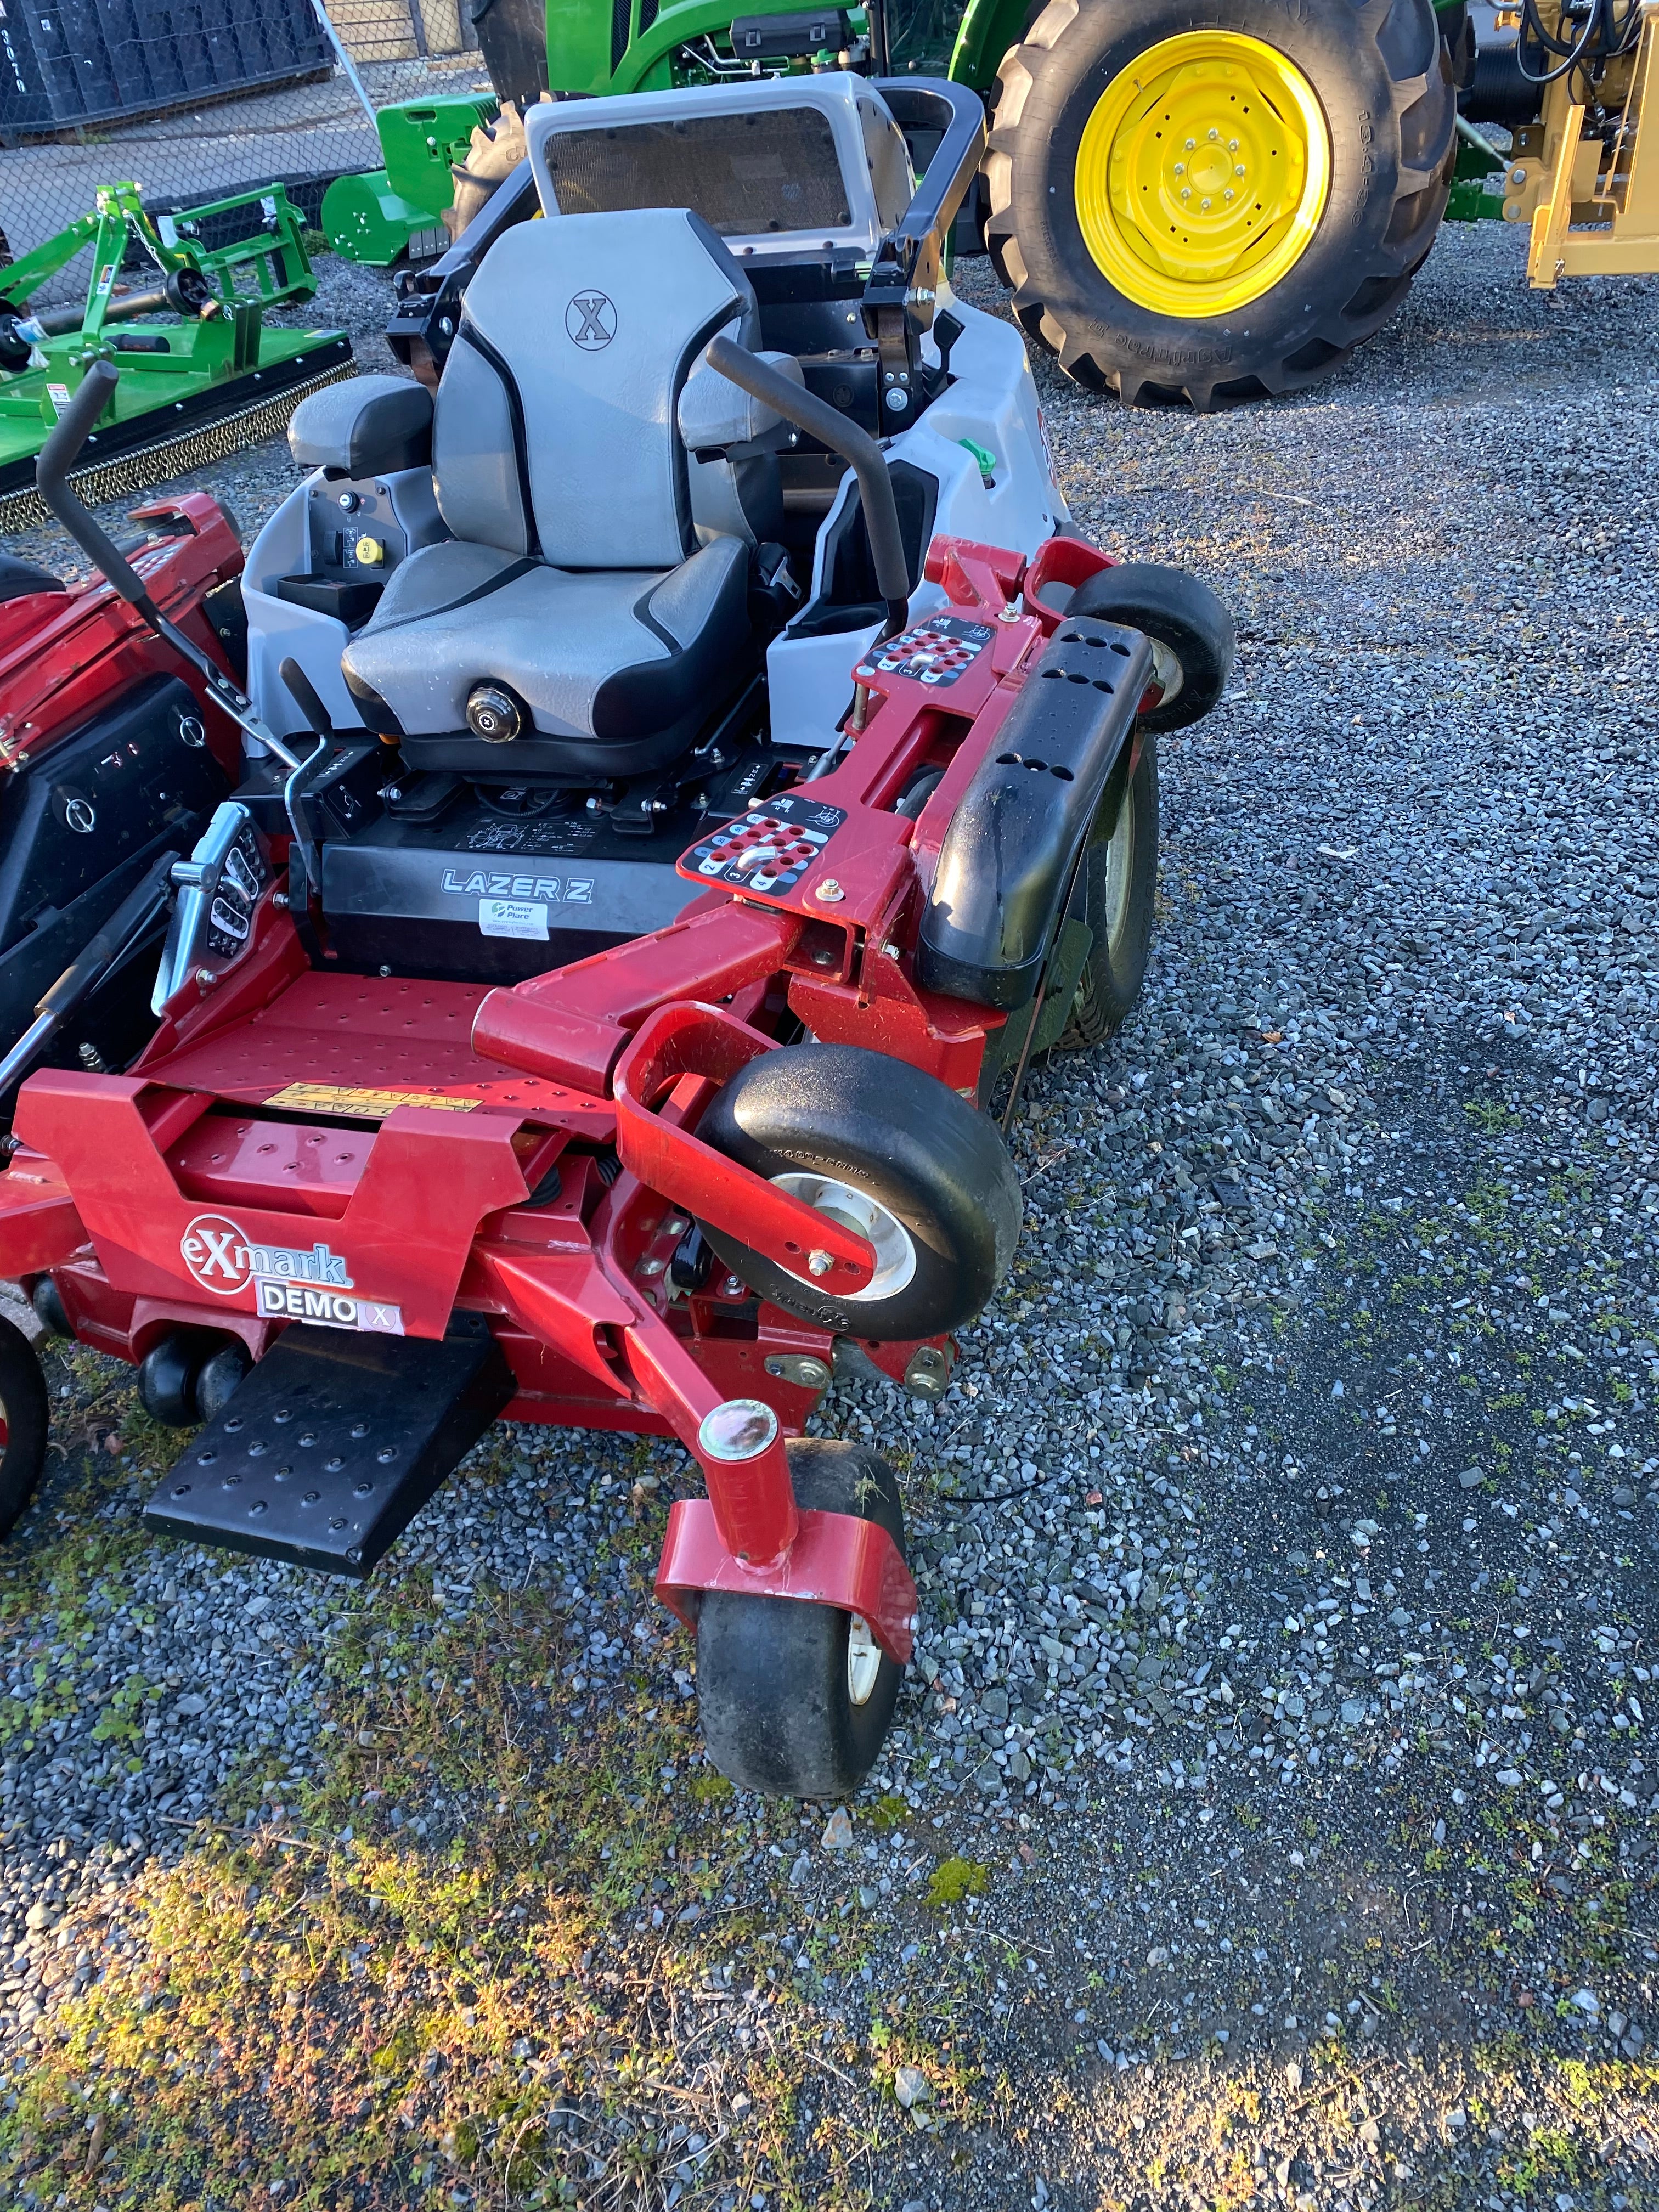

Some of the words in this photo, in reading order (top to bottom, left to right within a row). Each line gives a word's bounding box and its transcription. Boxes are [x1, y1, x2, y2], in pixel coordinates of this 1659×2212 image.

[573, 298, 610, 340] X
[1114, 333, 1233, 366] AgriTrac
[442, 870, 560, 901] LAZER
[564, 879, 593, 903] Z
[507, 904, 533, 913] Power
[183, 1229, 346, 1285] eXmark
[263, 1285, 357, 1322] DEMO
[370, 1307, 391, 1327] X
